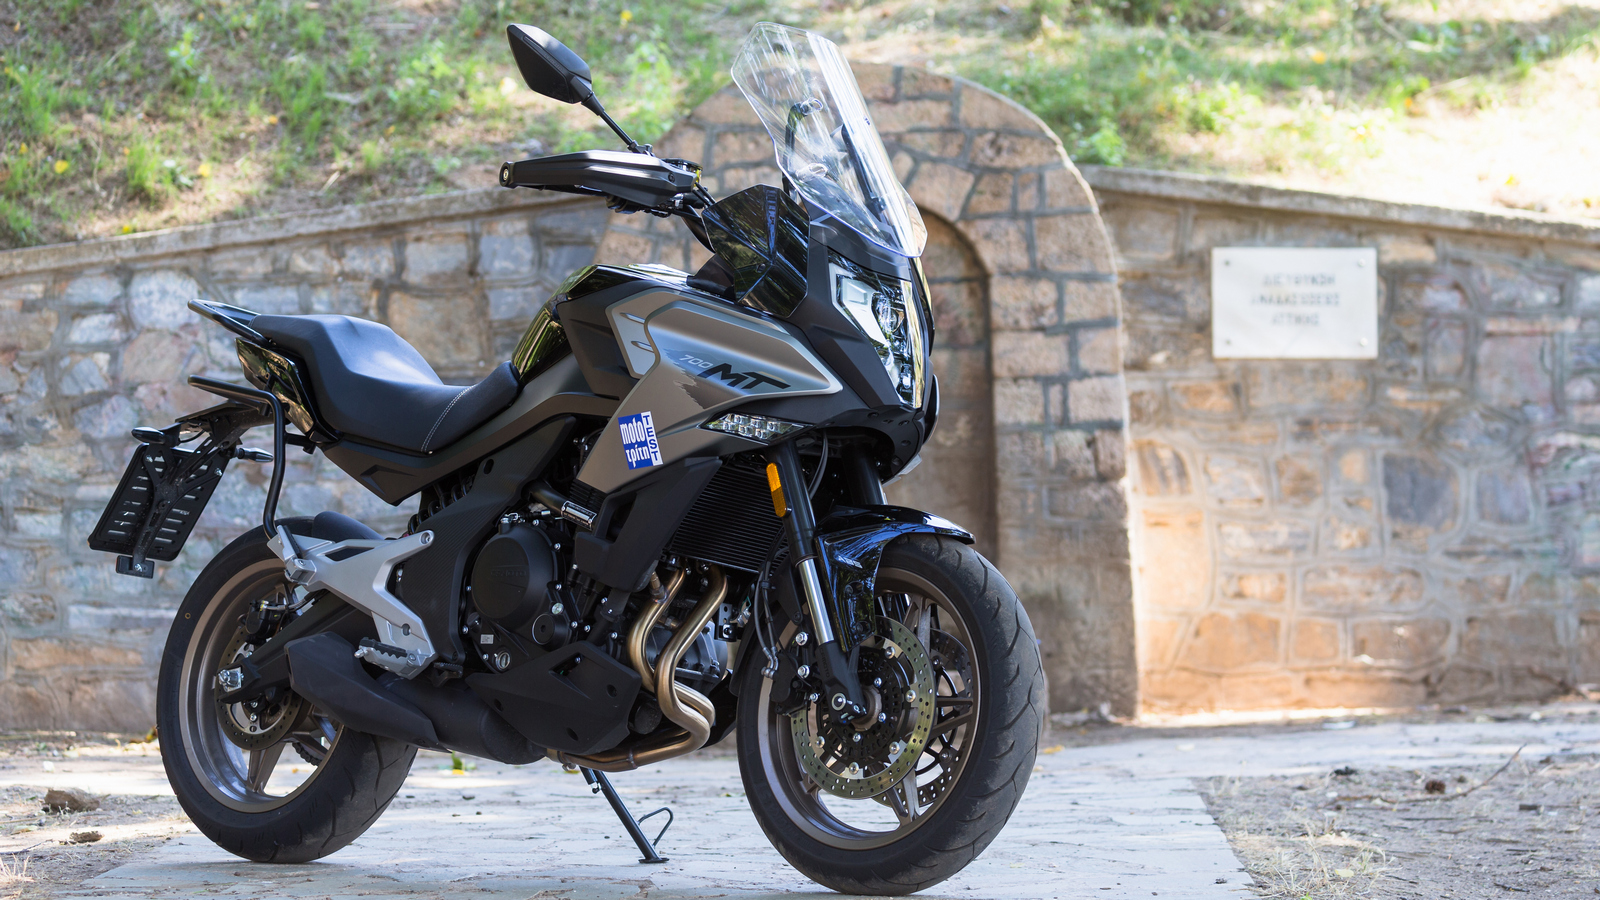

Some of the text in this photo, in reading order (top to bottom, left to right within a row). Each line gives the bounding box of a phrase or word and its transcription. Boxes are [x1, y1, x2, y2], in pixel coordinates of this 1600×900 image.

[679, 354, 791, 390] 700 MT
[619, 417, 646, 445] moto
[642, 414, 659, 461] TEST
